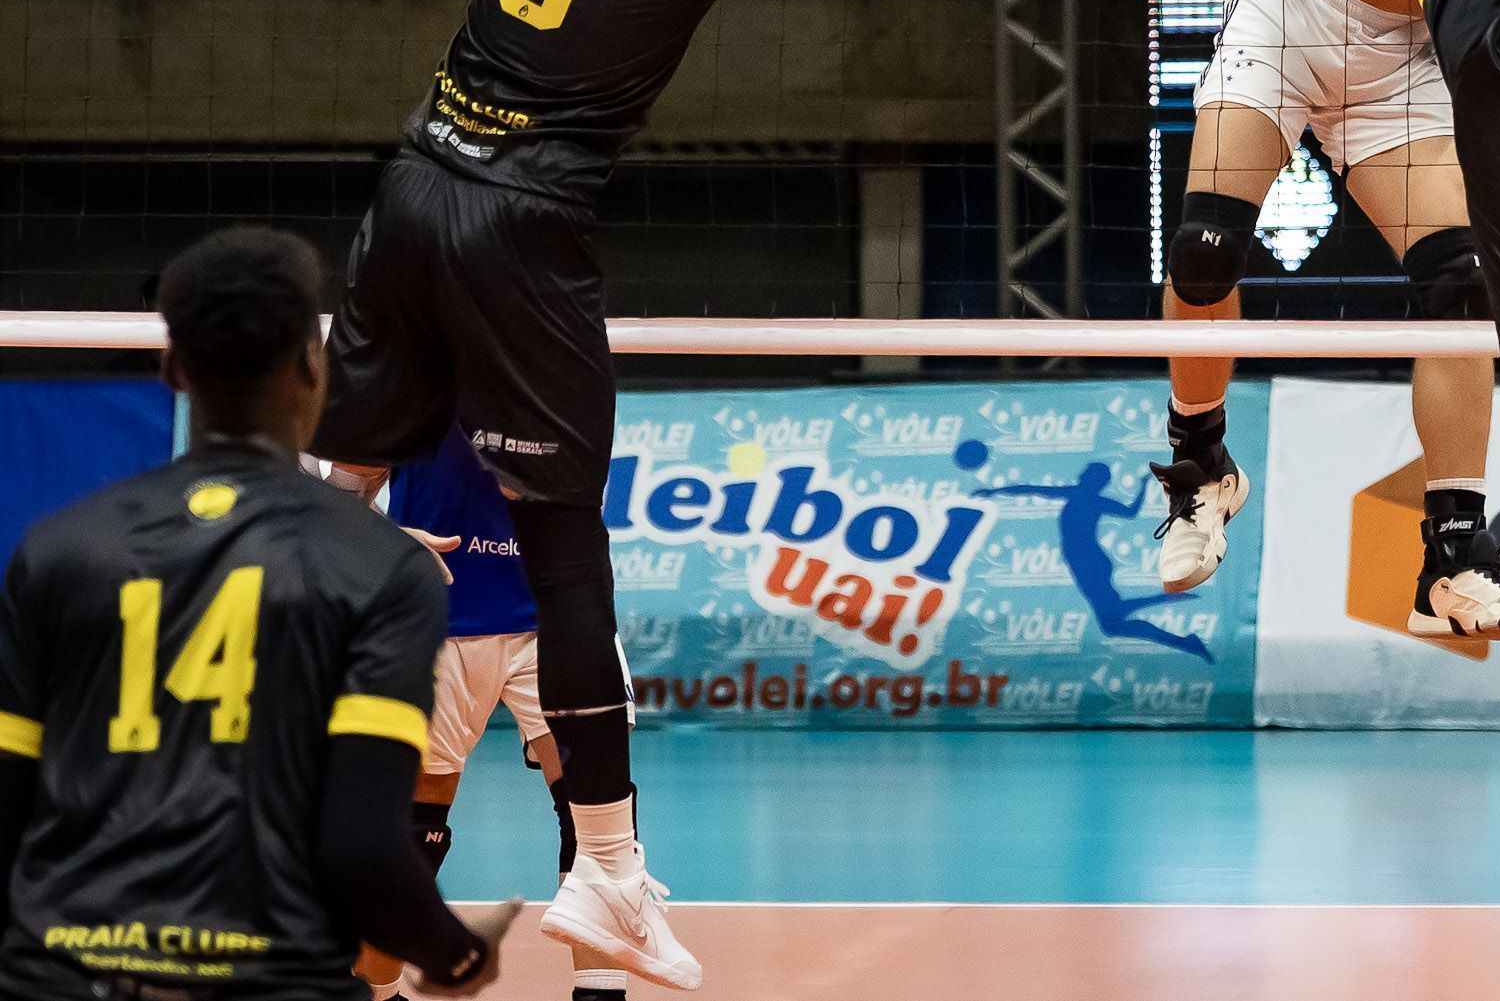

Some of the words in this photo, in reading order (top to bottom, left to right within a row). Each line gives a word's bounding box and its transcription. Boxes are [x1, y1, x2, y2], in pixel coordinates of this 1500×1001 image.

[1202, 230, 1221, 246] N1
[756, 415, 834, 446] VÔLEI
[882, 411, 963, 443] VÔLEI
[1020, 409, 1099, 441] VÔLEI
[764, 547, 944, 656] uai!
[1005, 605, 1088, 641] VÔLEI
[109, 566, 264, 754] 14
[1131, 678, 1213, 711] VÔLEI
[44, 921, 149, 951] PRAIA
